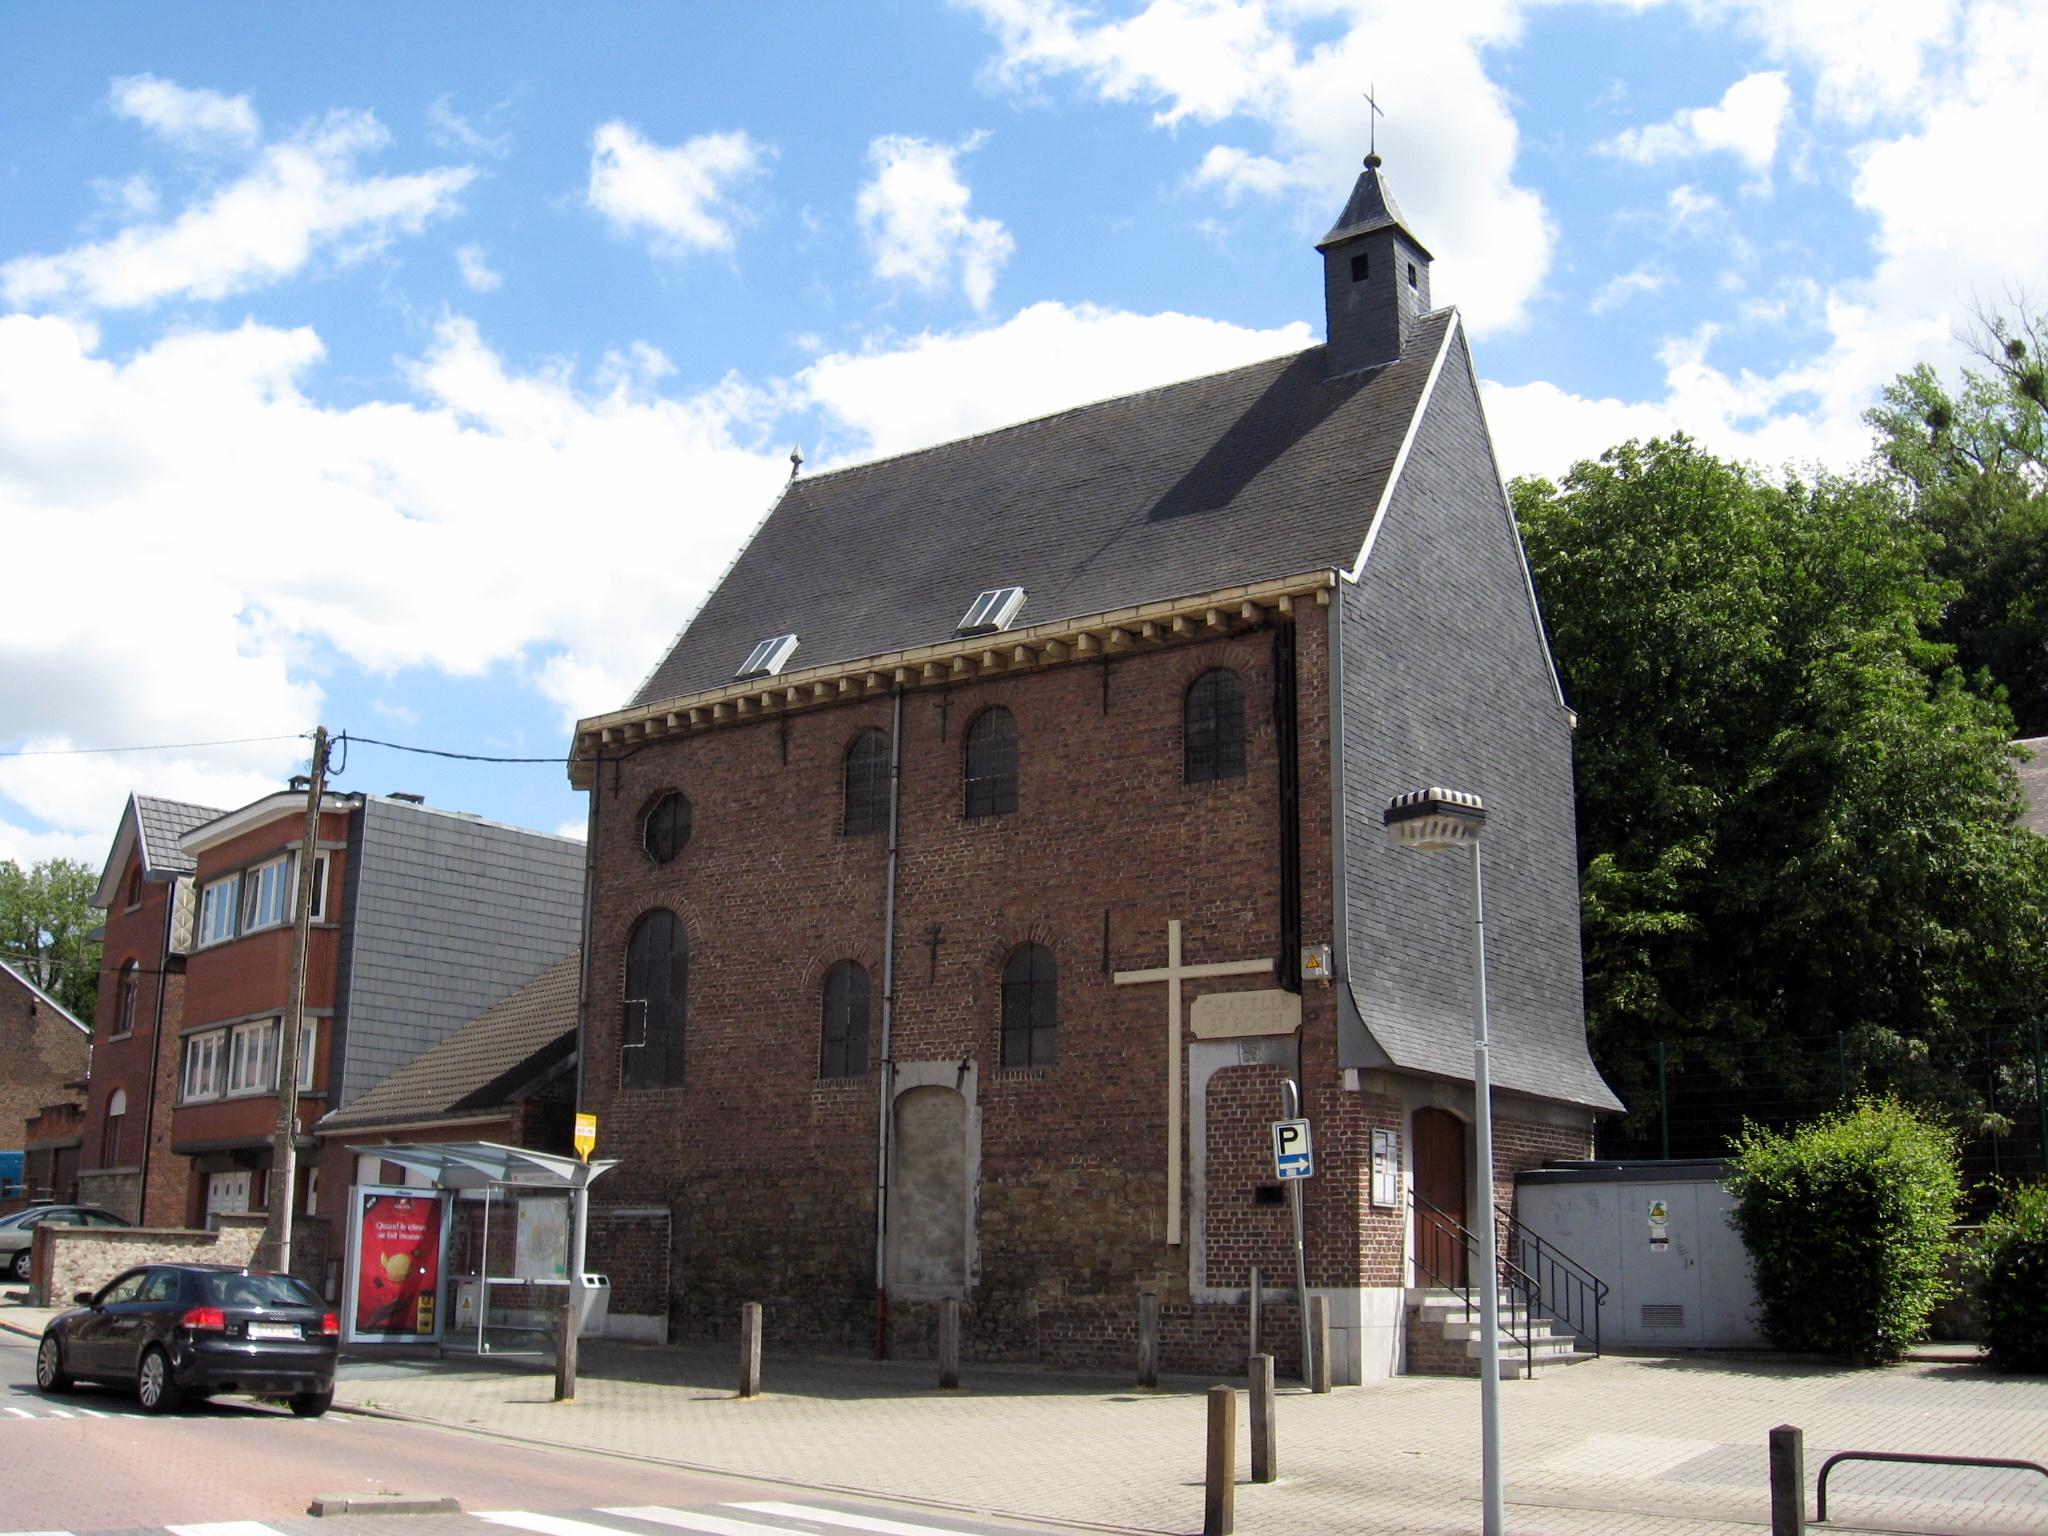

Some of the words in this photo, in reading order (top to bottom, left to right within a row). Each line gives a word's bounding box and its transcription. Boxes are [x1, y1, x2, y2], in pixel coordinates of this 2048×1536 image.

[1203, 995, 1289, 1015] CHAPELLE
[1232, 1013, 1283, 1033] ROCH
[1279, 1127, 1298, 1154] P
[376, 1222, 399, 1231] Quand
[400, 1222, 407, 1231] le
[407, 1223, 426, 1232] citron
[386, 1231, 398, 1240] fait
